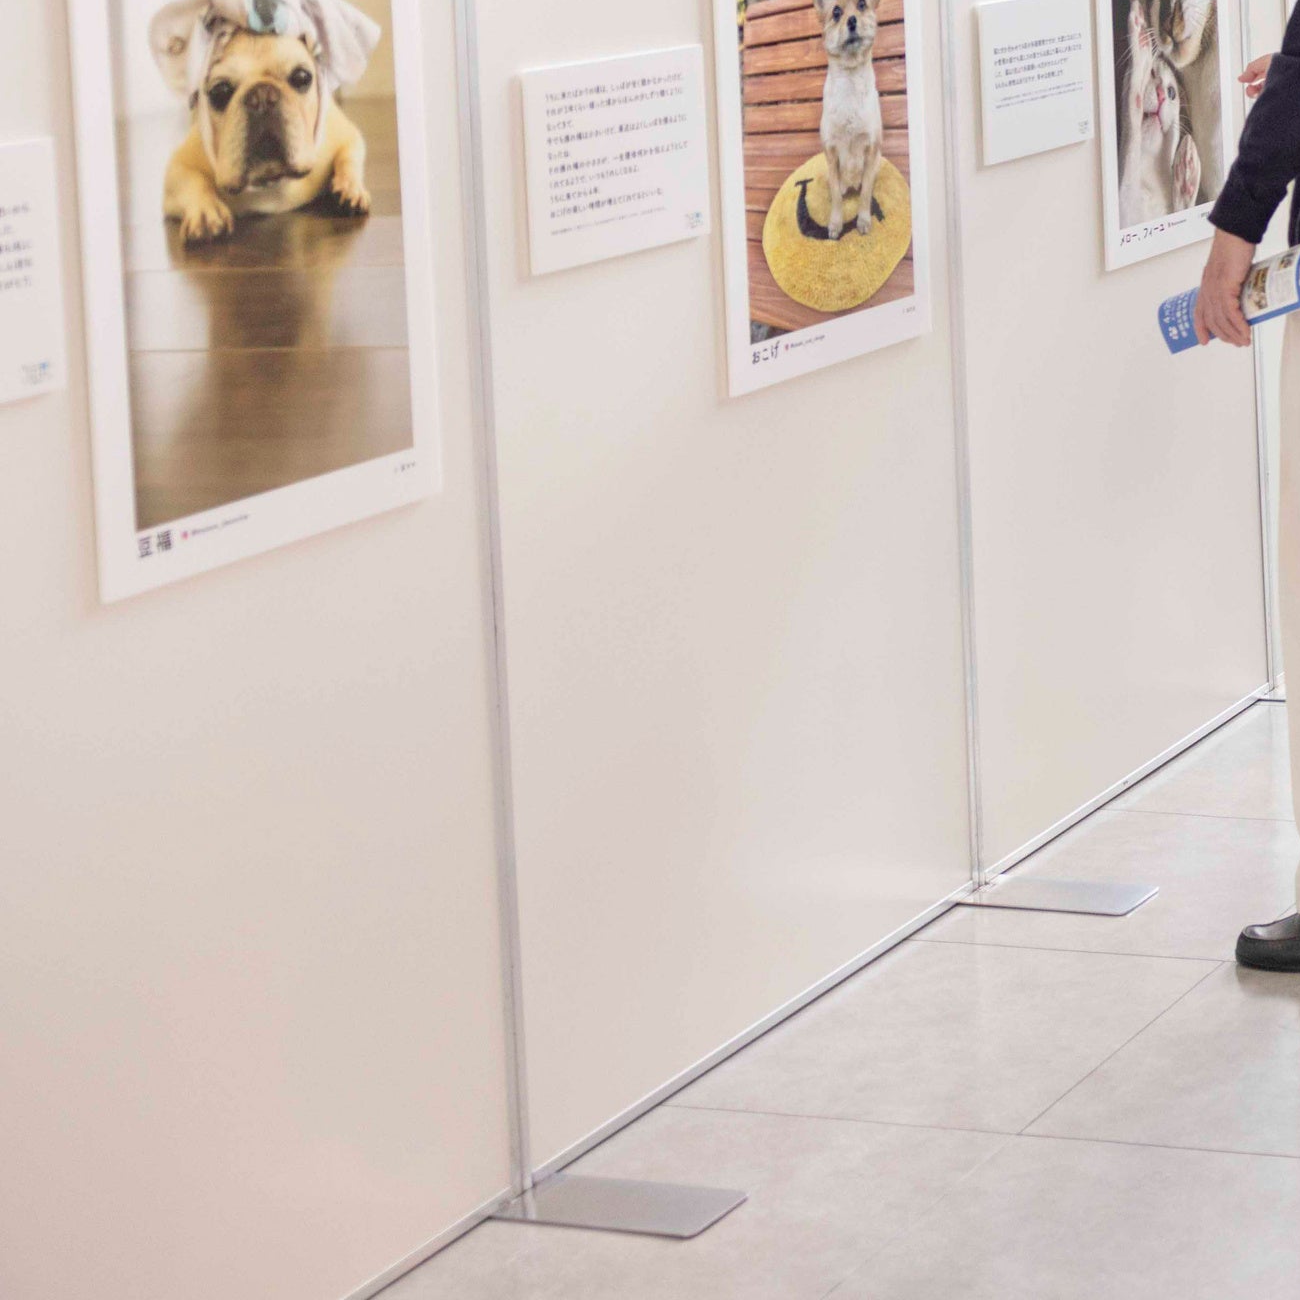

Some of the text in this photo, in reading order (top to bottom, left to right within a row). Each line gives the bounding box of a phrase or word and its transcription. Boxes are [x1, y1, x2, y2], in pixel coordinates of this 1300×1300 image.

[752, 340, 780, 365] おこげ
[138, 531, 173, 558] 豆福
